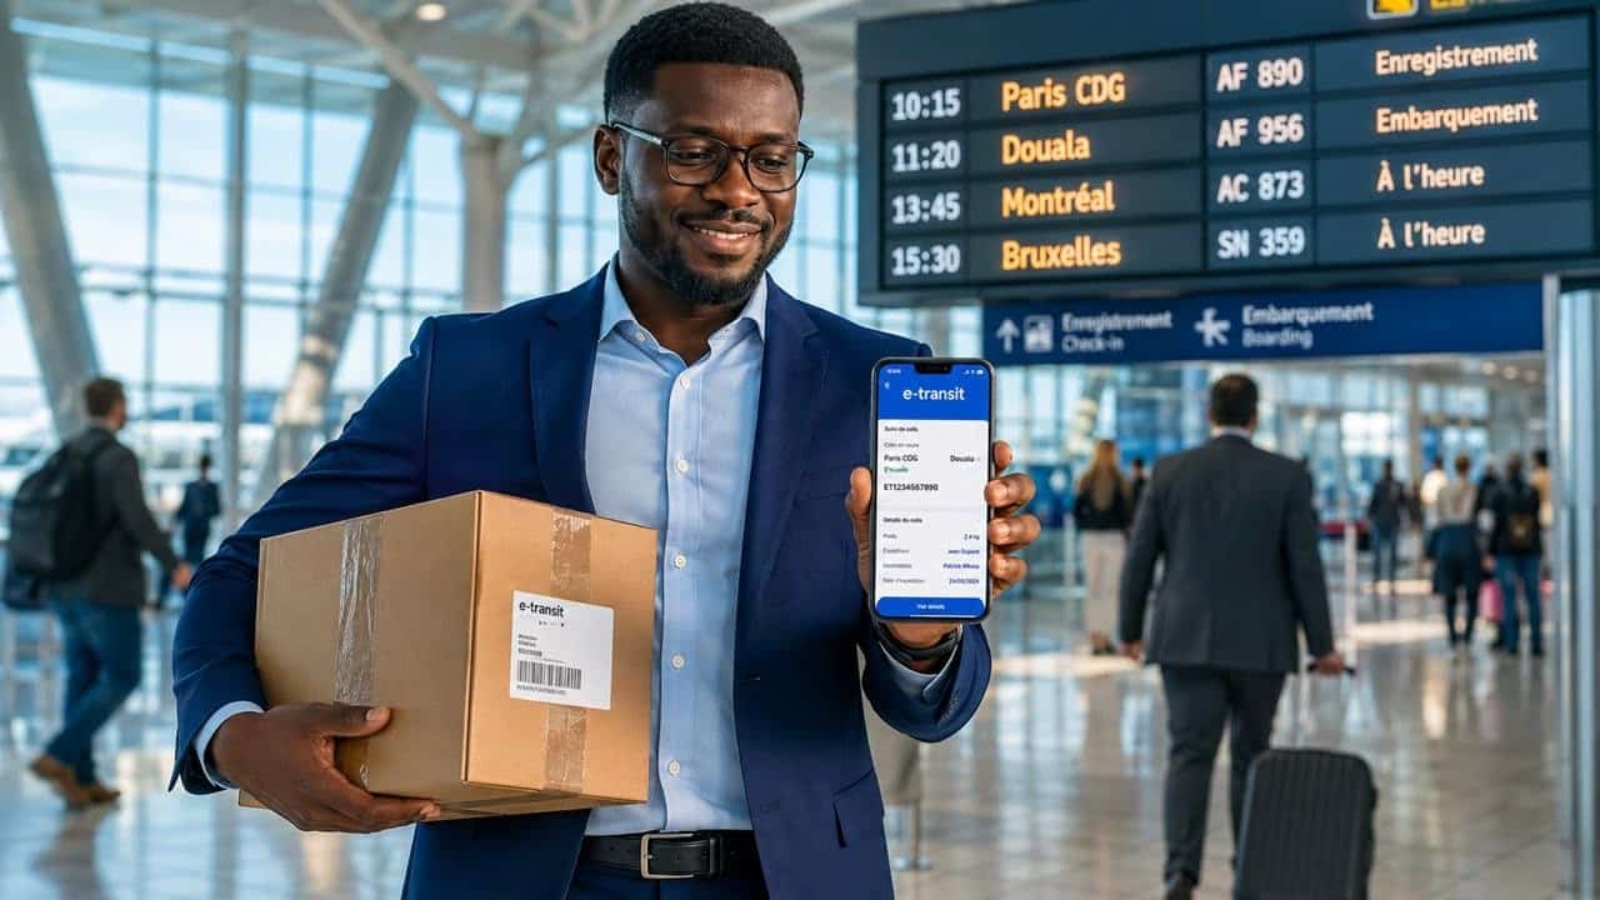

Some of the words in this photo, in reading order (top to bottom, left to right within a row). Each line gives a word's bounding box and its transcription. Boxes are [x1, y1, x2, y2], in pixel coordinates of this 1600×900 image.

[1376, 38, 1538, 76] Enregistrement
[1217, 62, 1248, 92] AF
[1258, 58, 1304, 88] 890
[892, 88, 961, 120] 10:15
[1002, 78, 1066, 112] Paris
[1075, 73, 1126, 105] CDG
[1217, 118, 1248, 148] AF
[1258, 114, 1304, 144] 956
[1376, 98, 1538, 133] Embarquement
[892, 140, 961, 172] 11:20
[1002, 129, 1090, 164] Douala
[1217, 174, 1249, 203] AC
[1259, 170, 1304, 199] 873
[1376, 160, 1395, 192] À
[1404, 163, 1485, 190] l'heure
[892, 192, 961, 224] 13:45
[1002, 180, 1115, 218] Montréal
[1217, 230, 1249, 259] SN
[1259, 227, 1305, 257] 359
[1377, 218, 1395, 249] À
[1404, 221, 1485, 248] l'heure
[892, 244, 961, 276] 15:30
[1002, 235, 1121, 270] Bruxelles
[1242, 302, 1374, 327] Embarquement
[1062, 335, 1124, 354] Check-in
[1242, 327, 1314, 349] Boarding
[902, 387, 965, 400] e-transit
[519, 601, 564, 617] e-transit
